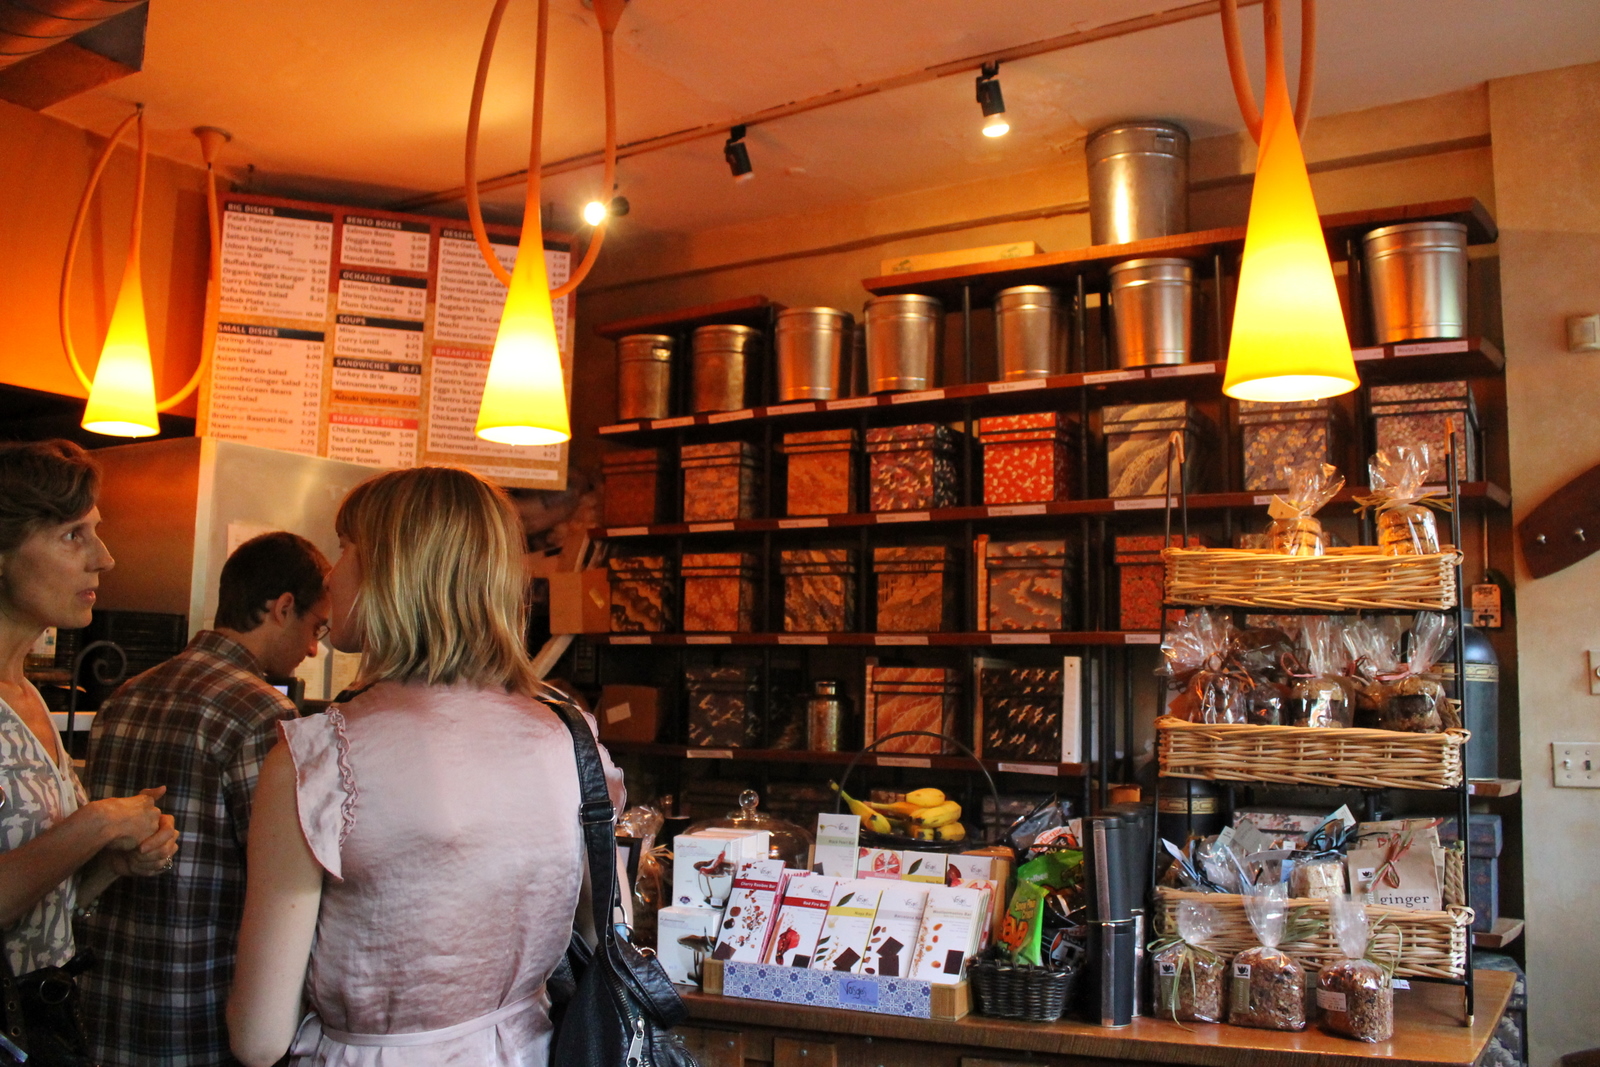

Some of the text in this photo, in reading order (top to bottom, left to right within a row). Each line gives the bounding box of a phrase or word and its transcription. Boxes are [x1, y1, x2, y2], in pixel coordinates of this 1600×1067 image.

[228, 203, 274, 215] BIG DISHES
[248, 216, 274, 224] Paneer
[346, 216, 402, 230] BENTO BOXES
[227, 223, 243, 231] Thai
[244, 225, 273, 233] Chicken
[274, 229, 294, 238] Curry
[346, 227, 373, 236] Salmon
[374, 231, 395, 239] Bento
[443, 229, 475, 240] DESSER
[226, 232, 249, 240] Seitan
[265, 236, 277, 244] Fry
[345, 236, 370, 245] Veggie
[371, 239, 392, 247] Bento
[225, 242, 294, 255] Udon Noodle Soup
[443, 240, 459, 249] Salty
[344, 245, 373, 254] Chicken
[374, 248, 395, 256] Bento
[442, 249, 477, 259] Chocolate
[223, 258, 250, 266] Buffalo
[250, 261, 275, 270] Burger
[343, 254, 396, 266] Handroll Bento
[441, 258, 486, 269] Coconut Rice
[222, 267, 305, 282] Organic Veggie Burger
[342, 271, 391, 284] OCHAZUKES
[441, 267, 492, 279] Jasmine Creme
[221, 277, 295, 290] Curry Chicken Salad
[440, 275, 488, 287] Chocolate Silk
[221, 286, 288, 299] Tofu Noodle Salad
[342, 282, 405, 295] Salmon Ochazuke
[440, 285, 503, 297] Shortbread Cookie
[220, 295, 244, 303] Kebab
[341, 291, 403, 304] Shrimp Ochazuke
[440, 294, 462, 302] Toffee
[462, 296, 489, 305] Granola
[340, 300, 395, 313] Plum Ochazuke
[472, 305, 486, 314] Trio
[339, 315, 366, 325] SOUPS
[438, 311, 487, 323] Hungarian Tea
[218, 324, 279, 337] SMALL DISHES
[438, 321, 460, 329] Mochi
[218, 336, 244, 344] Shrimp
[338, 336, 358, 344] Curry
[437, 330, 491, 341] Dolcezza Gelato
[217, 345, 272, 356] Seaweed Salad
[337, 345, 392, 356] Chinese Noodle
[435, 347, 480, 359] BREAKFAST
[216, 354, 236, 362] Asian
[215, 363, 287, 376] Sweet Potato Salad
[336, 359, 419, 373] SANDWICHES (M-F)
[435, 359, 474, 369] Sourdough
[336, 370, 360, 379] Turkey
[434, 368, 458, 376] French
[214, 373, 301, 387] Cucumber Ginger Salad
[433, 377, 462, 386] Cilantro
[214, 383, 292, 396] Sauteed Green Beans
[335, 380, 377, 389] Vietnamese
[378, 383, 398, 392] Wrap
[433, 386, 450, 395] Eggs
[212, 393, 258, 403] Green Salad
[334, 394, 399, 405] Adzuki Vegetarian
[433, 395, 461, 404] Cilantro
[213, 402, 229, 410] Tofu
[433, 404, 467, 414] Tea Cured
[211, 412, 237, 420] Brown
[246, 415, 276, 424] Basmati
[332, 415, 404, 427] BREAKFAST SIDES
[432, 414, 459, 422] Chicken
[331, 425, 391, 437] Chicken Sausage
[431, 423, 471, 432] Homemade
[210, 432, 247, 440] Edamame
[345, 436, 366, 444] Cured
[368, 438, 395, 446] Salmon
[446, 434, 476, 442] Oatmeal
[430, 442, 478, 451] Birchermuesli
[330, 454, 380, 464] Ginger Scones
[1380, 893, 1429, 908] ginger
